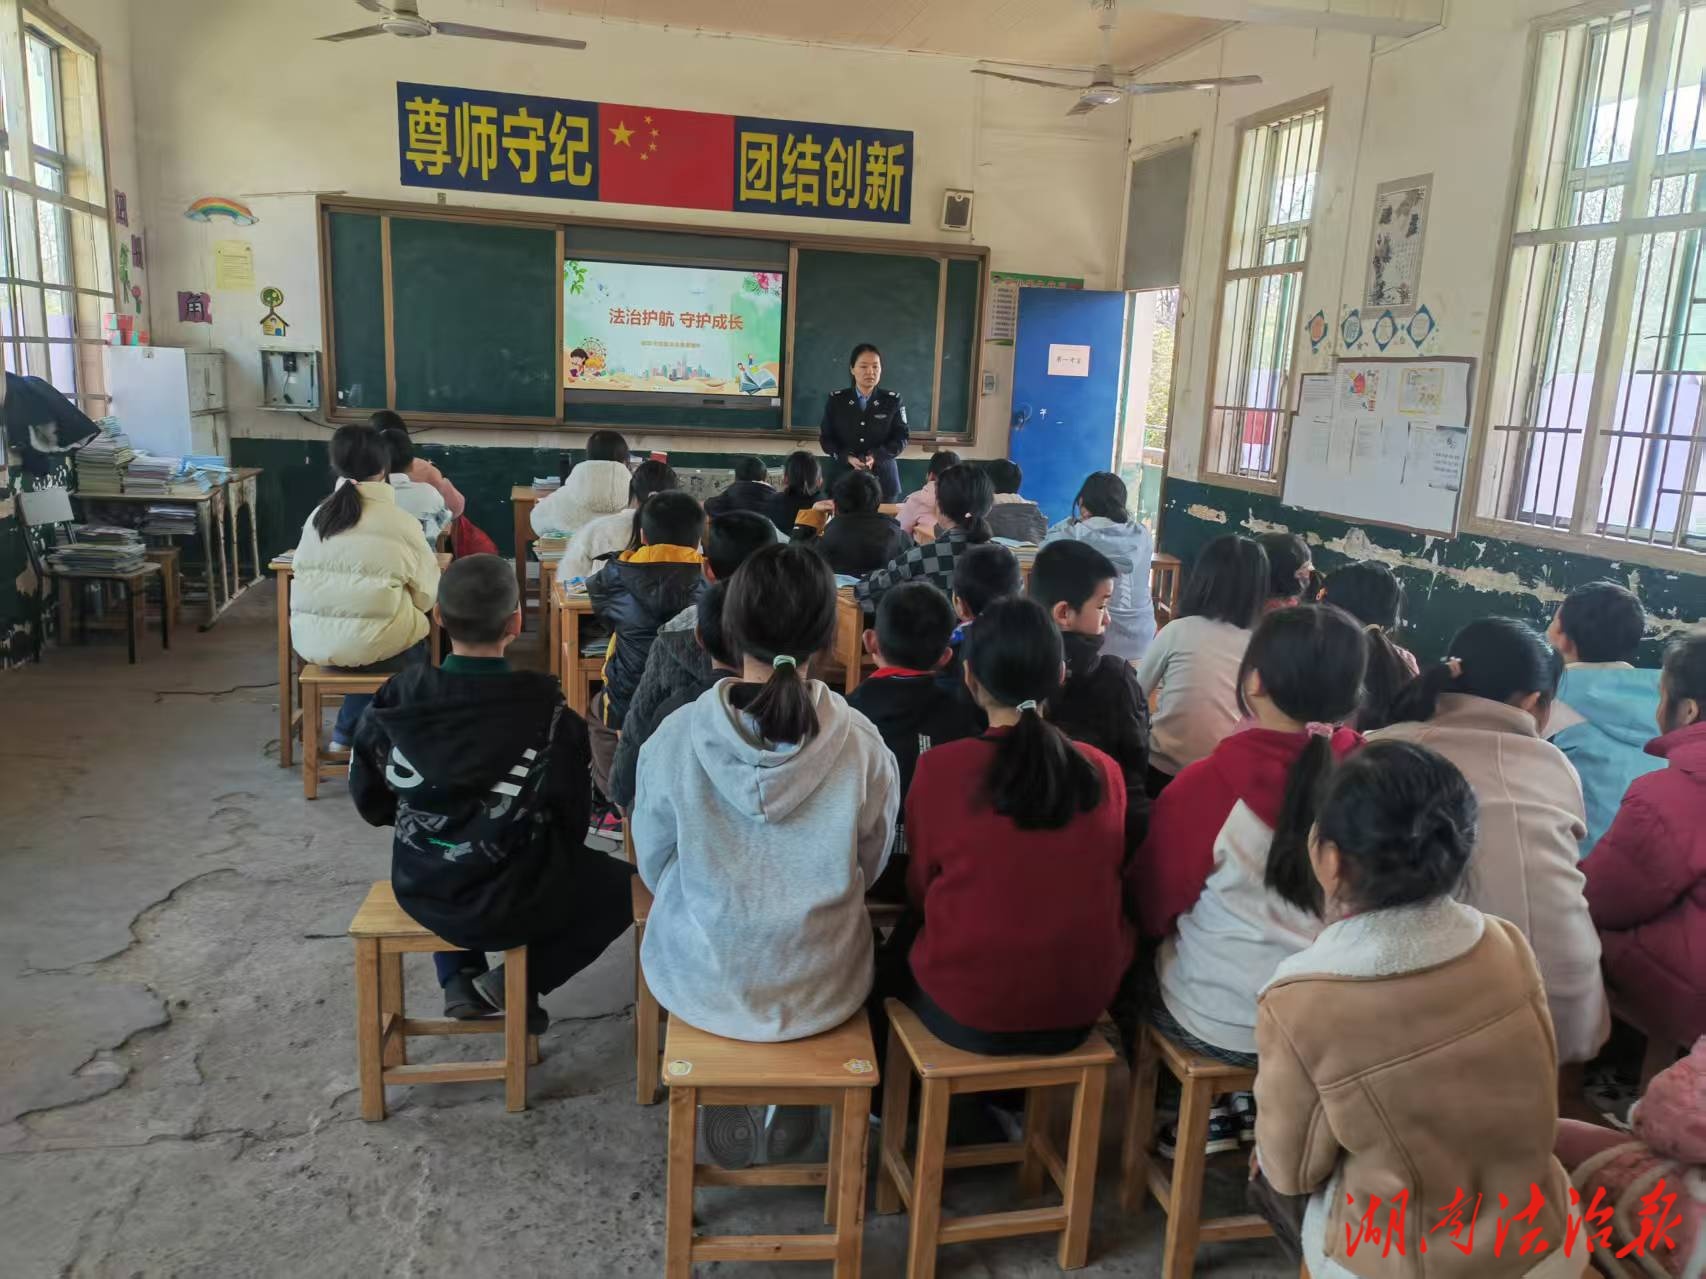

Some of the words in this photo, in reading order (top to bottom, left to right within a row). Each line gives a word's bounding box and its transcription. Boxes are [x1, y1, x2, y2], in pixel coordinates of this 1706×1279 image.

[405, 97, 593, 186] 尊师守纪
[739, 131, 905, 212] 团结创新
[609, 308, 675, 328] 法治护航
[679, 312, 744, 331] 守护成长
